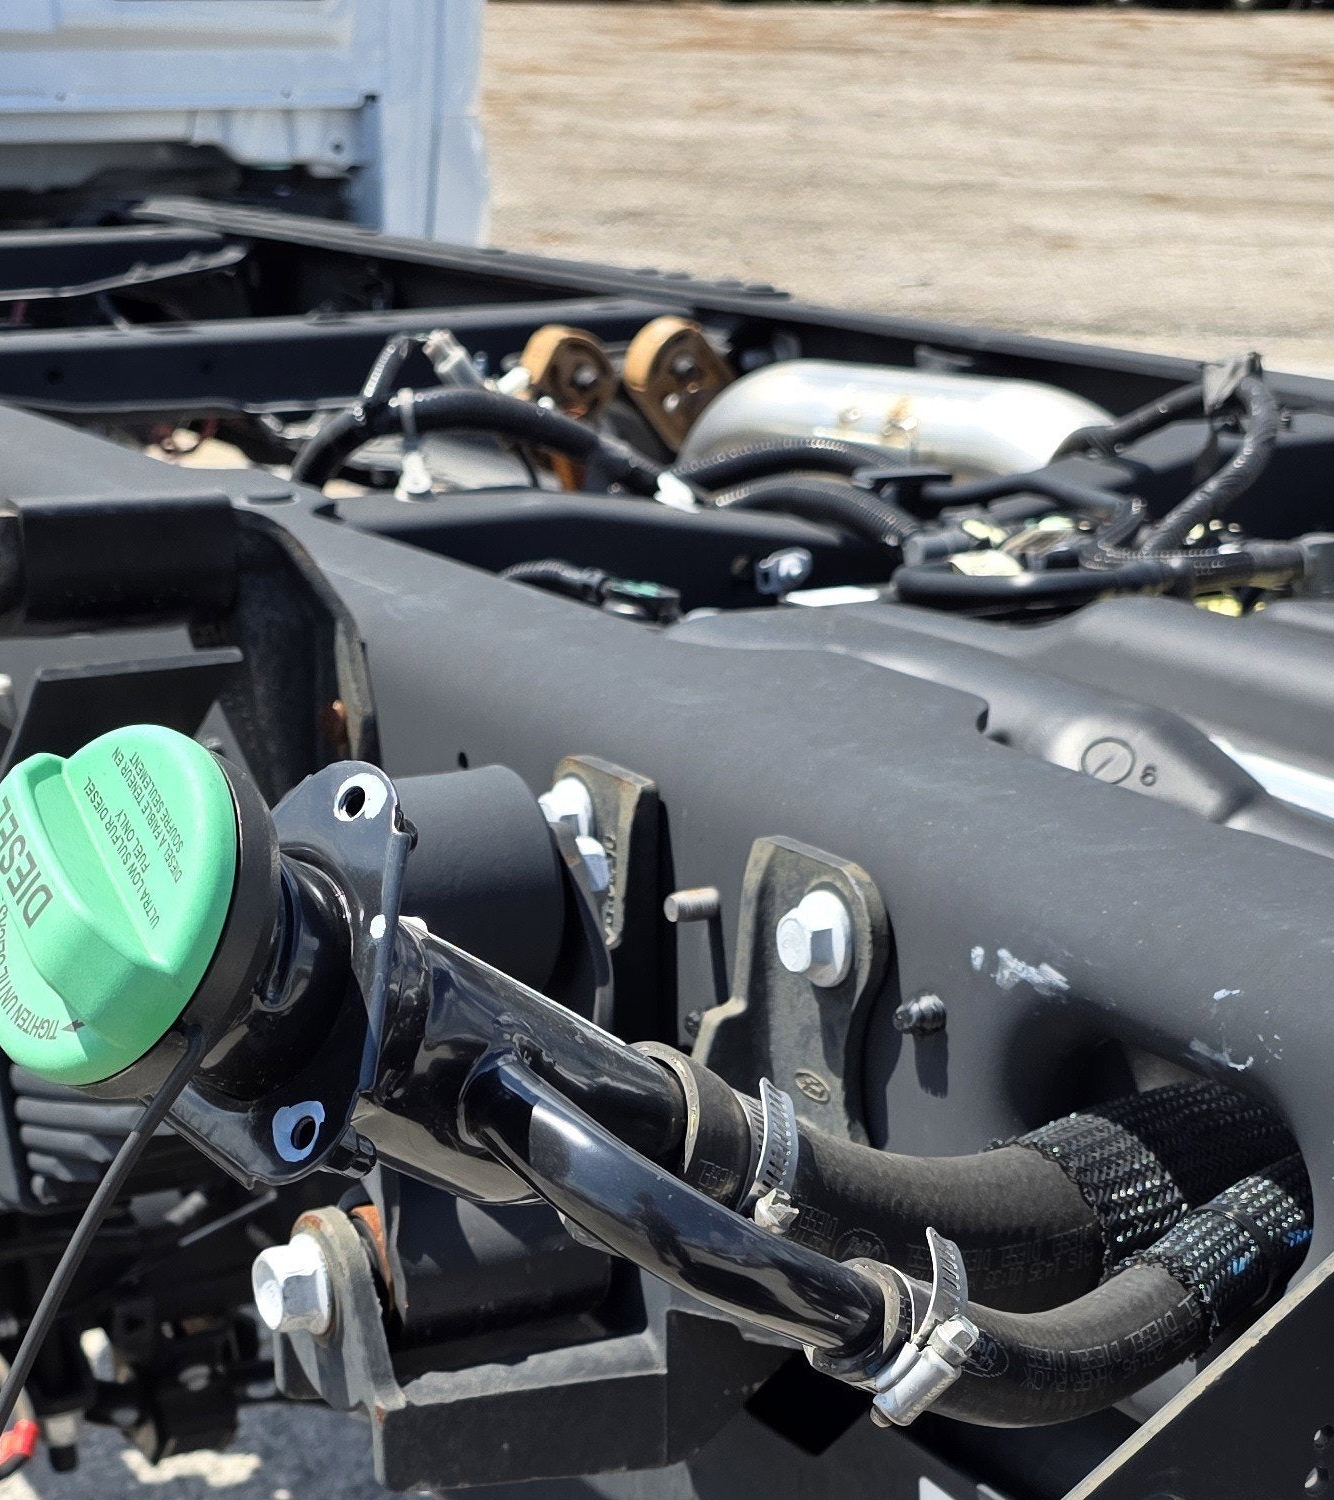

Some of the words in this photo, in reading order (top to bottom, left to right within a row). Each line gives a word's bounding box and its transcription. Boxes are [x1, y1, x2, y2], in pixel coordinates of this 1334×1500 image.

[111, 747, 124, 767] EN
[84, 776, 108, 821] DIESEL
[121, 762, 145, 806] TENEUR
[129, 752, 164, 813] SEULEMENT
[105, 816, 131, 865] SULFUR
[115, 809, 135, 842] ONLY
[141, 800, 163, 840] FAIBLE
[160, 808, 183, 853] SOUFRE
[133, 838, 150, 873] FUEL
[164, 842, 182, 883] DIESEL
[127, 862, 144, 893] LOW
[140, 887, 160, 930] ULTRA
[10, 1004, 59, 1040] TIGHTEN
